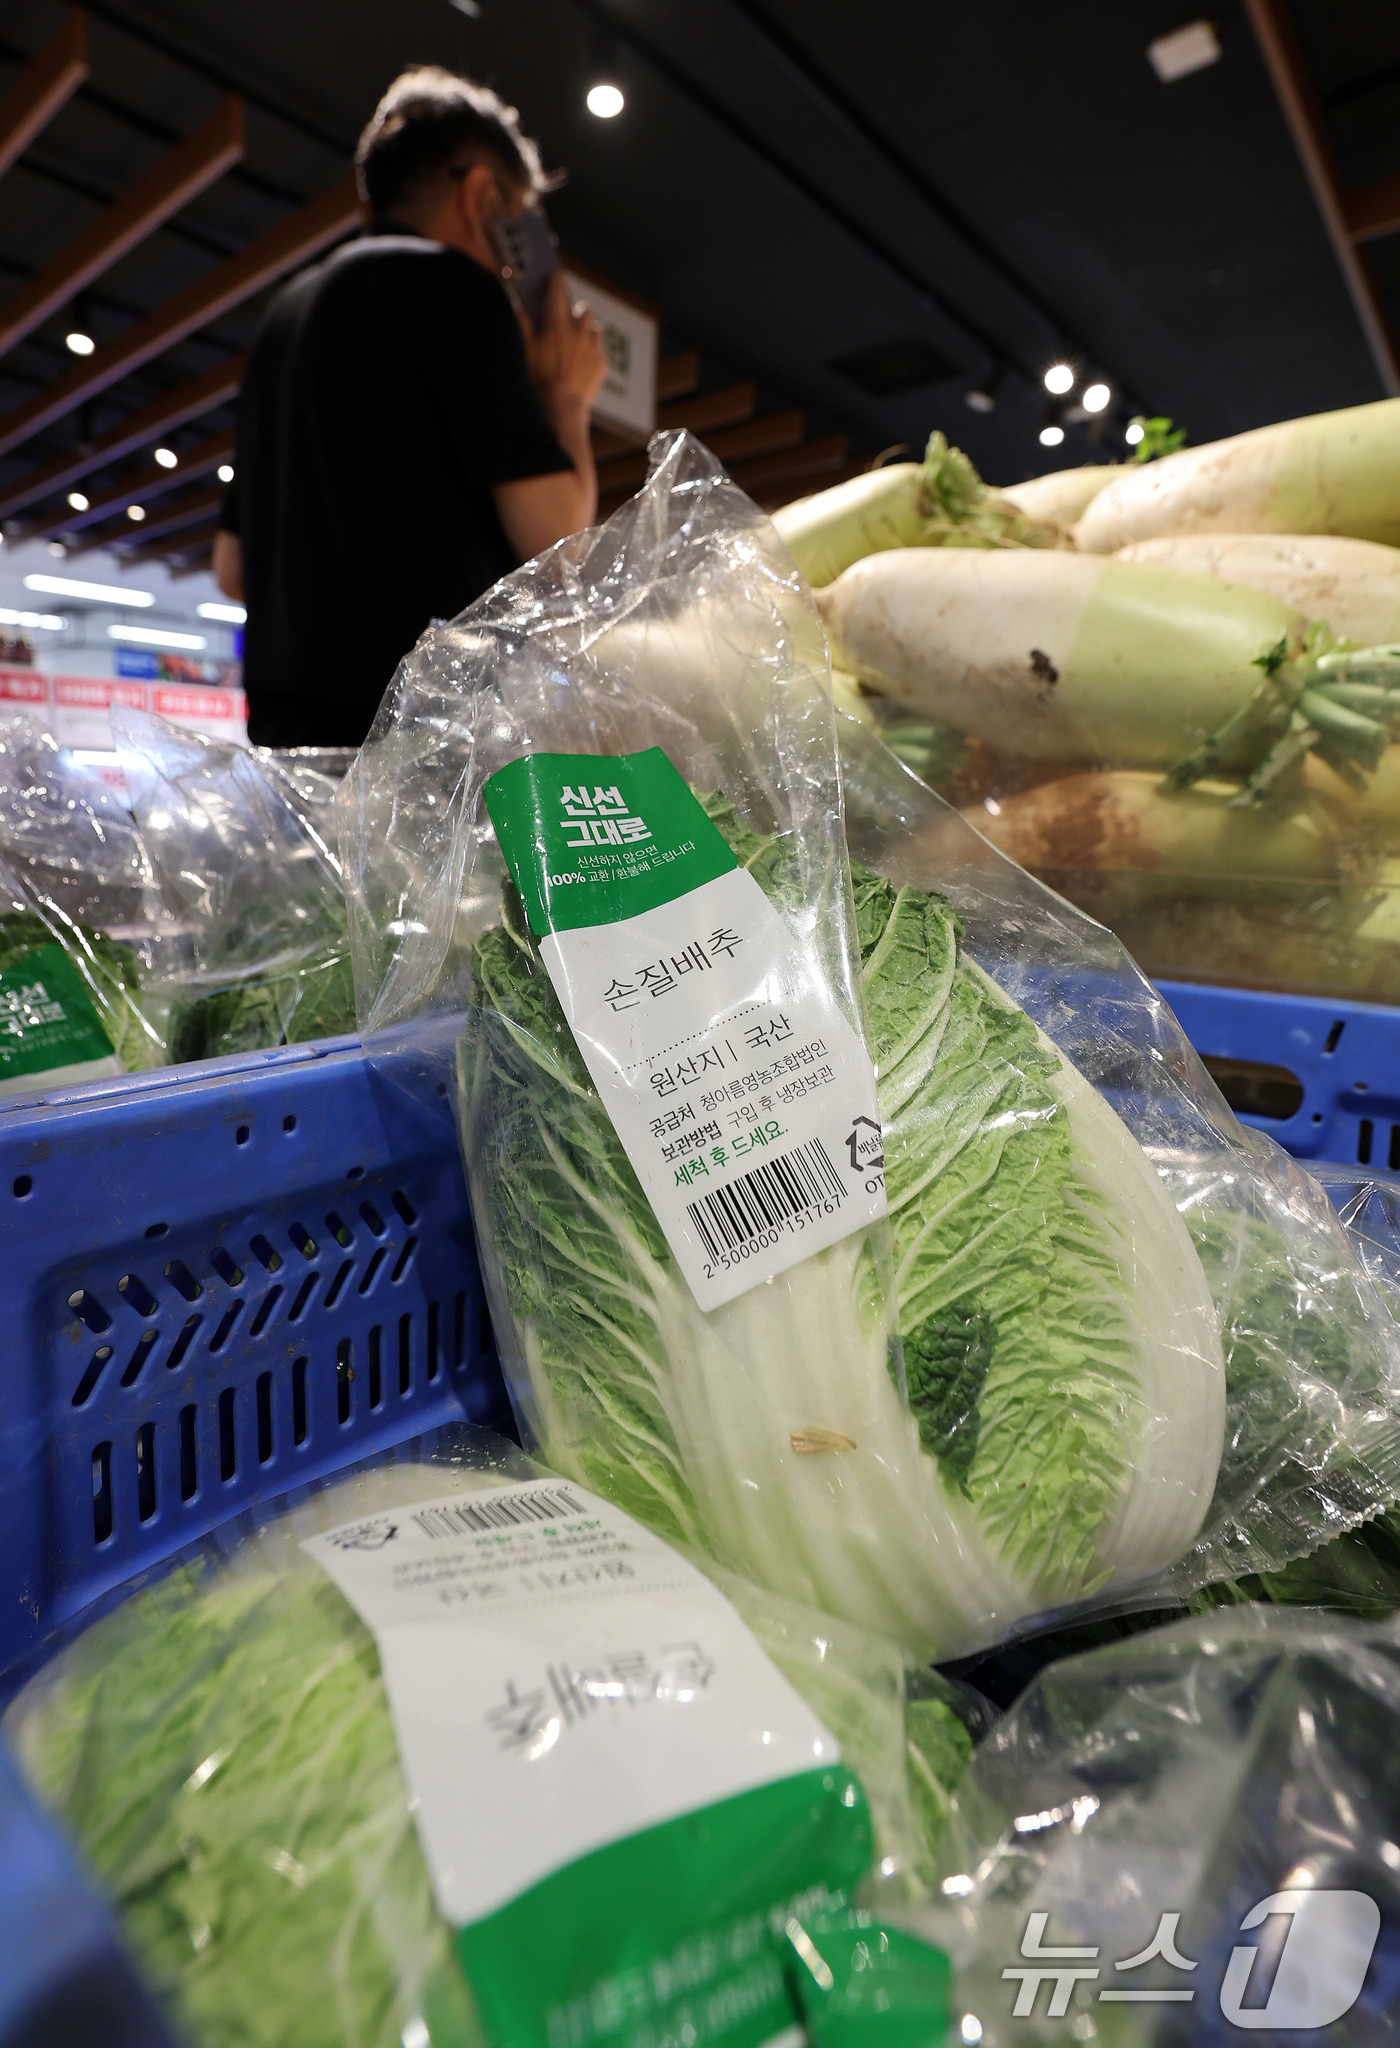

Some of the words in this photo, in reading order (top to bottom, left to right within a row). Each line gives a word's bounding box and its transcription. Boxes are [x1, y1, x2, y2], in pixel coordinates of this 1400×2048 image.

[560, 786, 630, 816] 신선
[560, 816, 653, 848] 그대로
[547, 871, 587, 888] 100%
[652, 840, 697, 867] 드립니다
[577, 854, 622, 869] 신선하지
[623, 844, 660, 865] 않으면
[602, 927, 744, 1013] 손질배추
[648, 1102, 697, 1138] 공급처
[700, 1038, 829, 1112] 청아름영농조합법인
[649, 1045, 726, 1098] 원산지
[743, 1013, 794, 1049] 국산
[661, 1119, 723, 1163] 보관방법
[726, 1102, 759, 1129] 구입
[758, 1095, 776, 1113] 후
[776, 1064, 837, 1104] 냉장보관
[673, 1155, 710, 1187] 세척
[709, 1146, 730, 1168] 후
[731, 1120, 789, 1158] 드세요.
[719, 1228, 780, 1271] 500000
[785, 1193, 844, 1234] 151767
